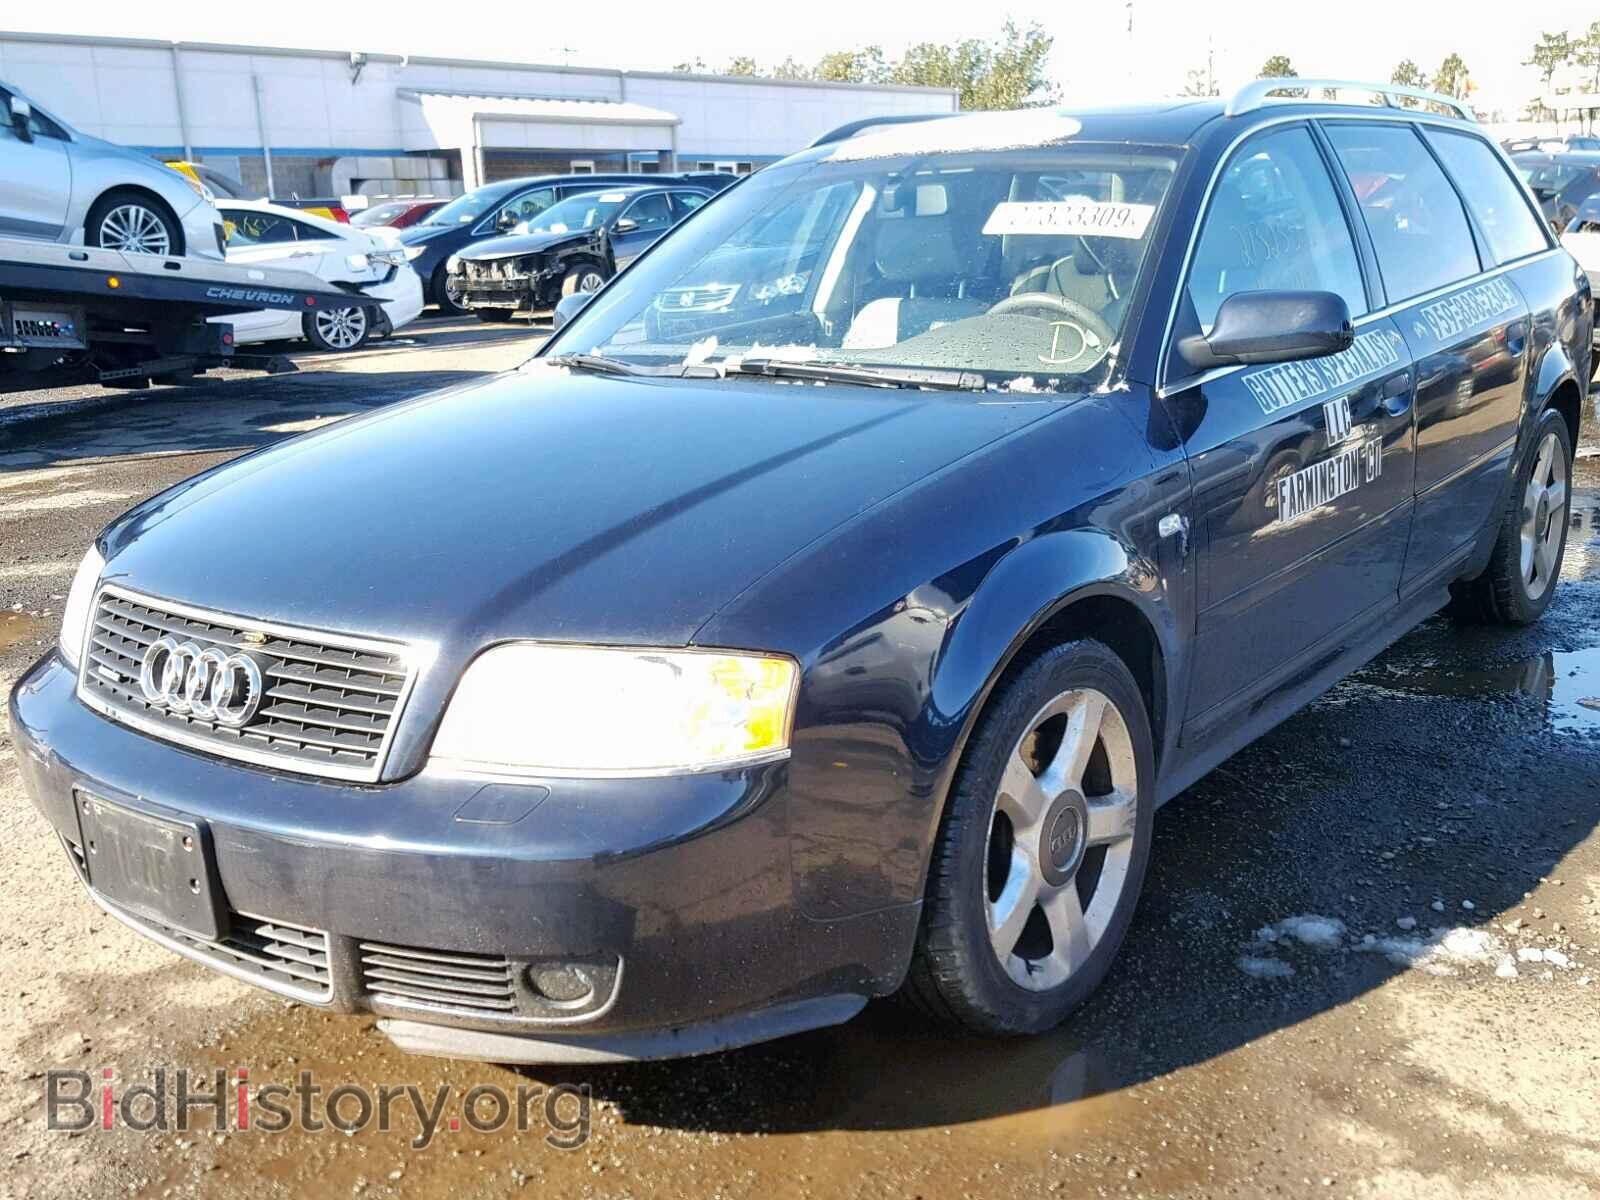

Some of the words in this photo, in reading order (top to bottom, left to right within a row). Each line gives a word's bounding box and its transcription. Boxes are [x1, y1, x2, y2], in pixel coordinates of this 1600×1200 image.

[206, 286, 295, 304] CHEVRON
[1319, 331, 1397, 386] SPECIALIST
[1325, 399, 1352, 446] LLC
[1278, 448, 1359, 522] FARMINGTON
